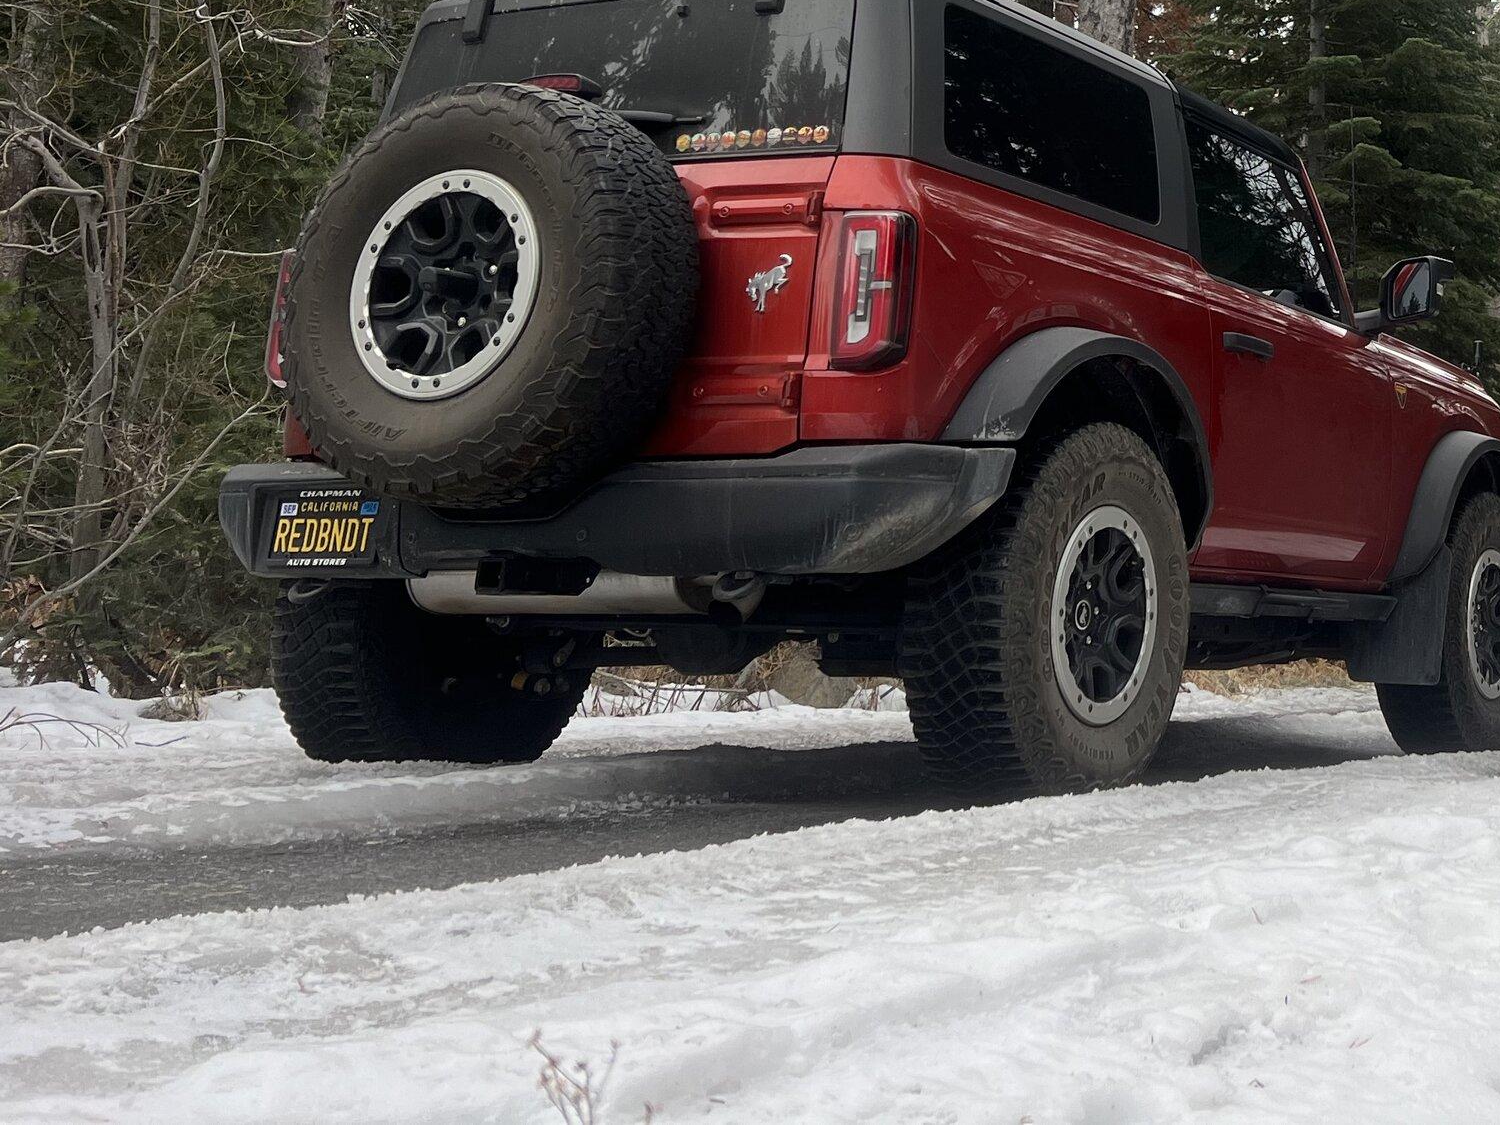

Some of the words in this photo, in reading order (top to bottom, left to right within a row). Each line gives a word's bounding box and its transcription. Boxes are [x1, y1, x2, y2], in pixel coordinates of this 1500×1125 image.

[300, 489, 362, 498] CHAPMAN
[283, 504, 297, 514] SEP
[300, 501, 359, 513] CALIFORNIA
[273, 518, 375, 554] REDBNDT
[286, 558, 310, 566] AUTO
[312, 558, 347, 566] STORES
[1124, 553, 1184, 757] GOODYEAR
